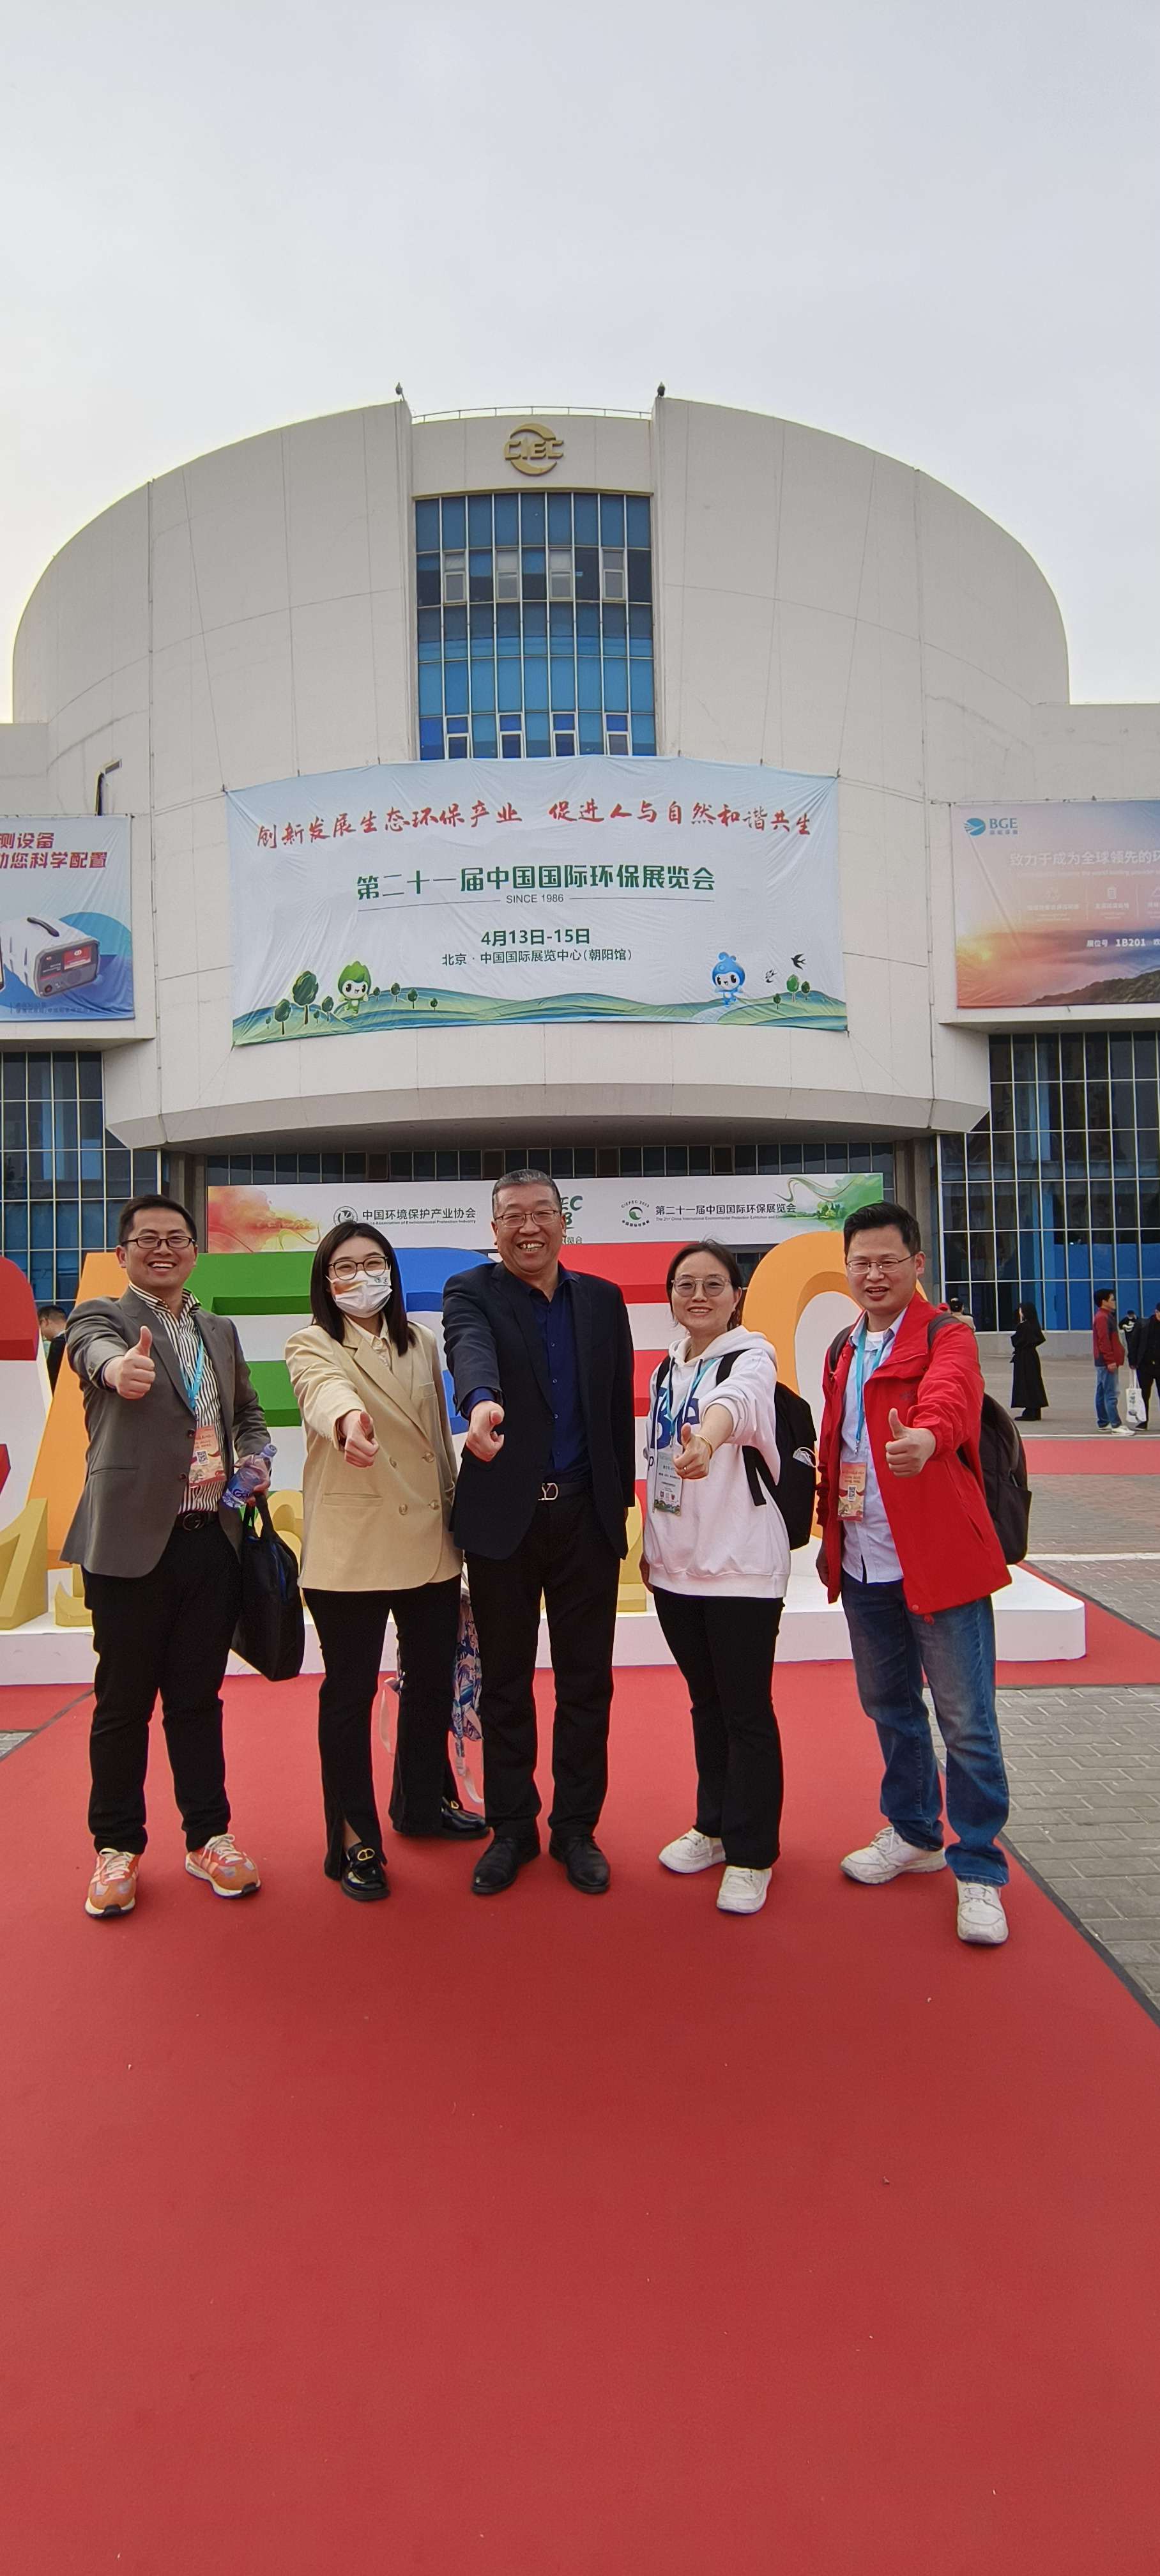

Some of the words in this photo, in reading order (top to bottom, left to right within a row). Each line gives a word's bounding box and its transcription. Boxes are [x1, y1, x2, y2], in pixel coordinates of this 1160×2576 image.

[257, 799, 523, 848] 创新发展生态环保产业
[548, 798, 811, 835] 促进人与自然和谐共生
[989, 818, 1018, 829] BGE
[357, 864, 715, 900] 第二十一届中国国际环保展览会
[506, 895, 537, 904] SINCE
[542, 894, 564, 903] 1986
[480, 928, 590, 946] 4月13日-15日
[1115, 938, 1146, 947] 1B201
[362, 1208, 476, 1220] 中国环境保护产业协会
[655, 1203, 796, 1215] 第二十一届中国国际环保展览会
